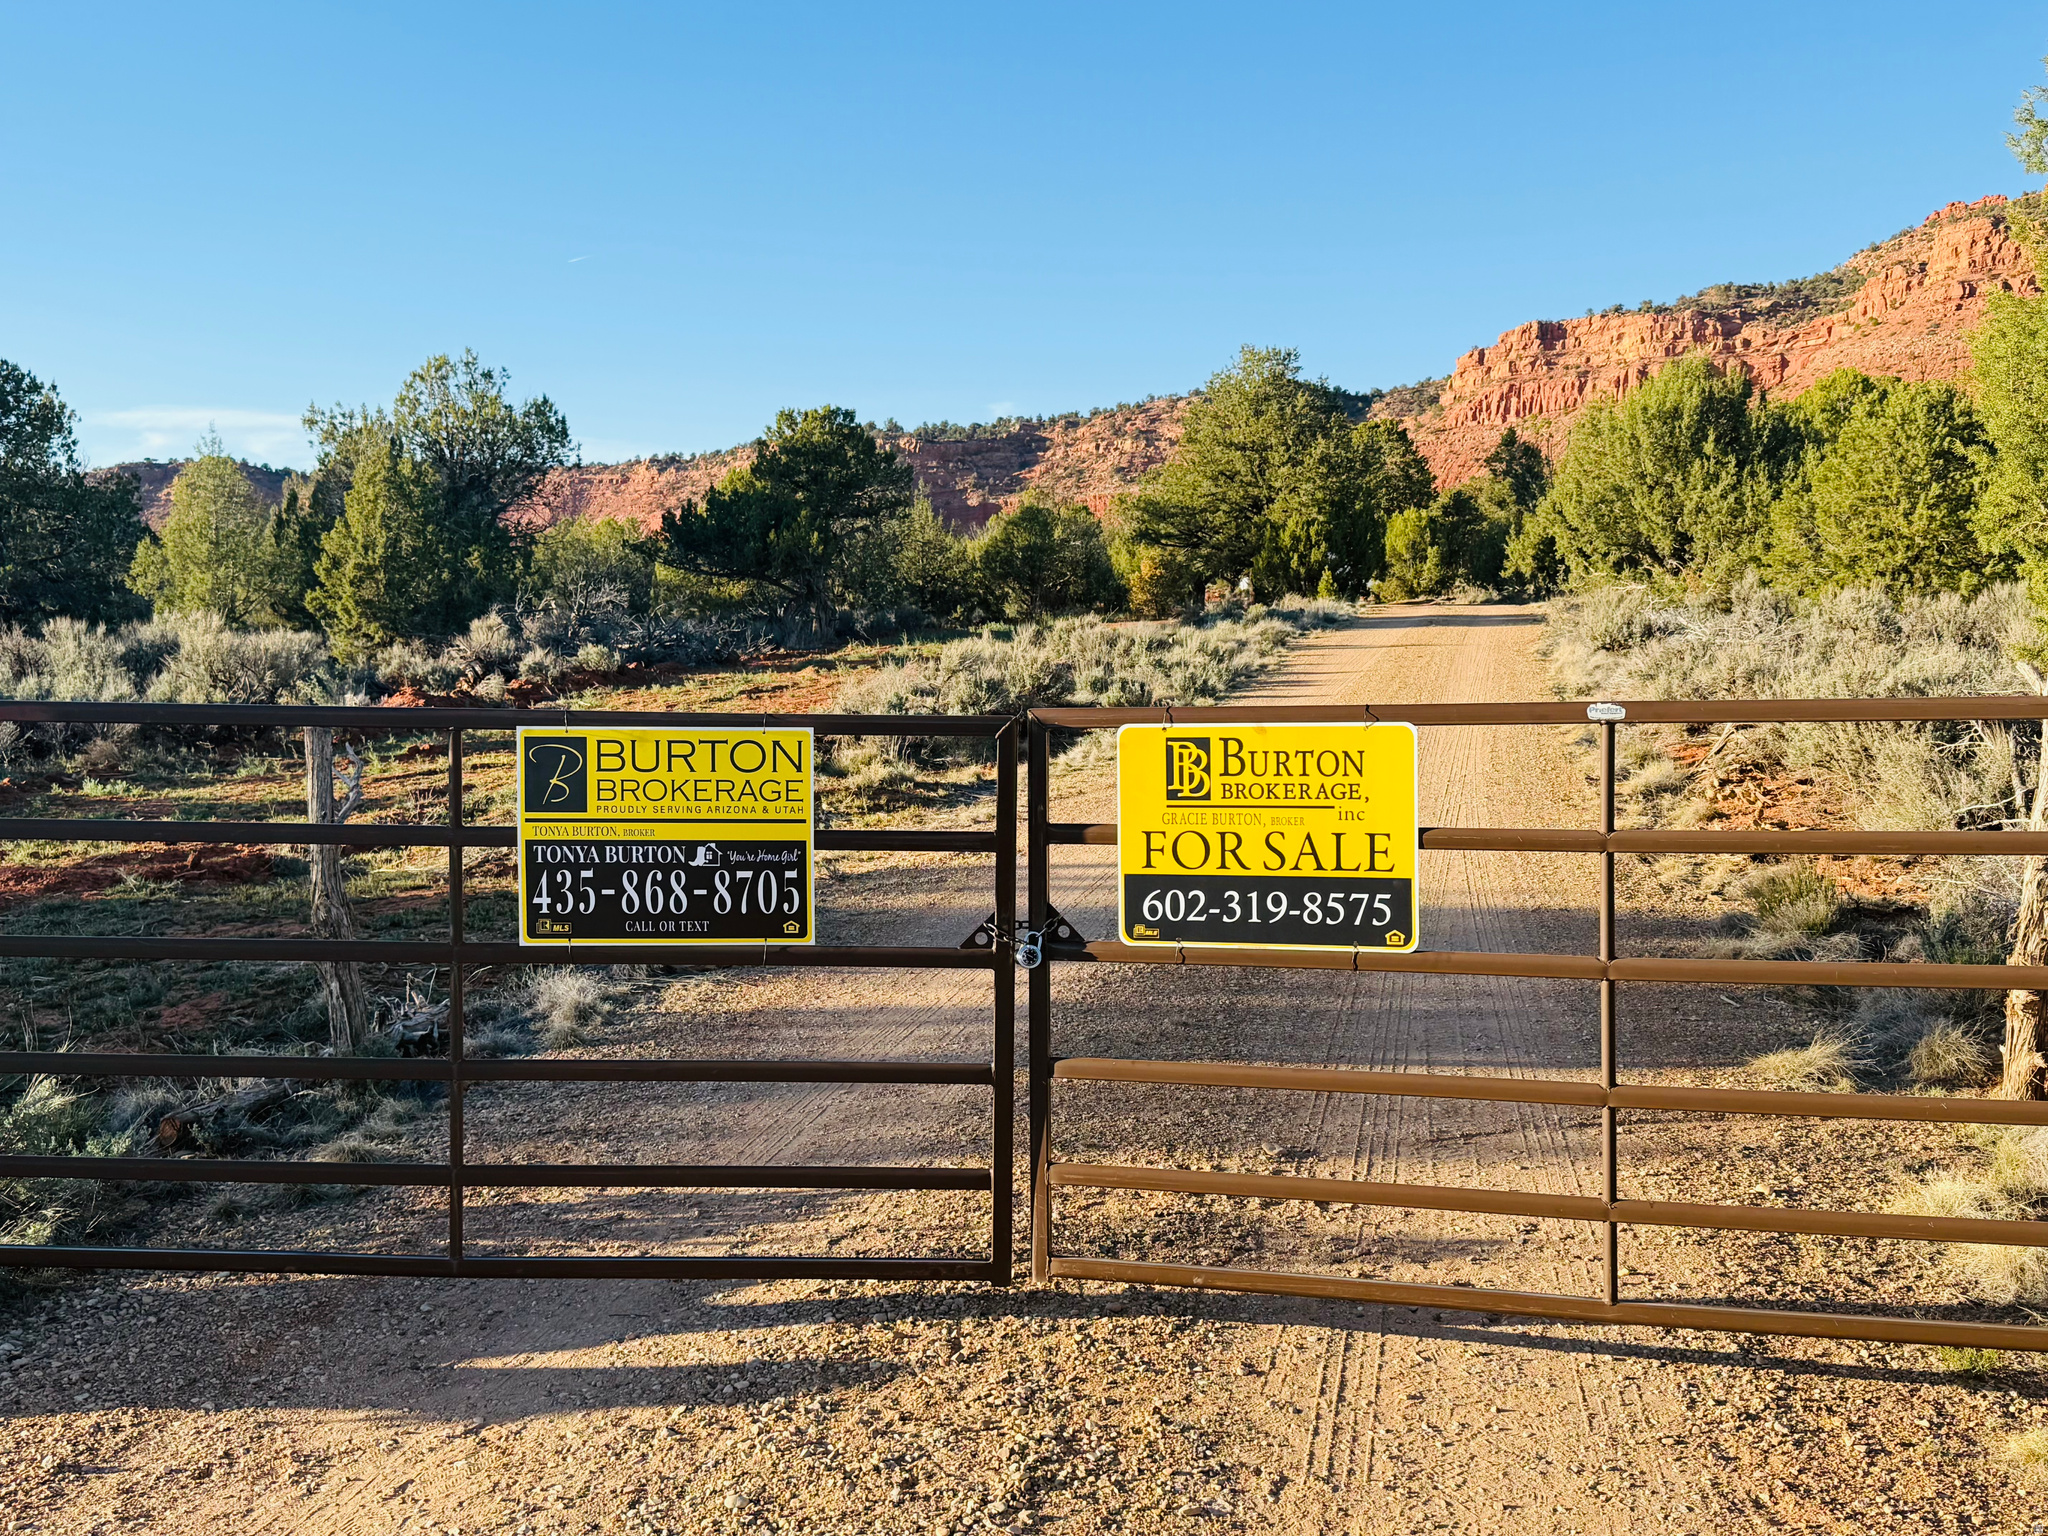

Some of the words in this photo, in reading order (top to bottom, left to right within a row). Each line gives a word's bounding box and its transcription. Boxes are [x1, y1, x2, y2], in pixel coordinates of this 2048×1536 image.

[596, 739, 803, 773] BURTON
[597, 779, 804, 802] BROKERAGE
[1222, 783, 1370, 803] BROKERAGE,
[596, 805, 647, 814] PROUDLY
[653, 805, 701, 814] SERVING
[706, 805, 757, 814] ARIZONA
[762, 805, 769, 814] &
[775, 805, 804, 814] UTAH
[1338, 806, 1365, 821] inc
[1162, 812, 1208, 825] GRACIE
[1212, 812, 1267, 828] BURTON,
[1271, 817, 1305, 826] BROKER
[532, 826, 570, 837] TONYA
[623, 828, 655, 837] BROKER
[533, 846, 601, 863] TONYA
[604, 846, 686, 863] BURTON
[757, 849, 780, 862] Home
[1141, 831, 1251, 871] FOR
[1263, 831, 1395, 872] SALE
[533, 868, 800, 914] 435-868-8705
[1142, 889, 1392, 926] 602-319-8575
[552, 924, 570, 932] MLS
[625, 920, 655, 932] CALL
[659, 920, 675, 932] OR
[679, 920, 709, 932] TEXT
